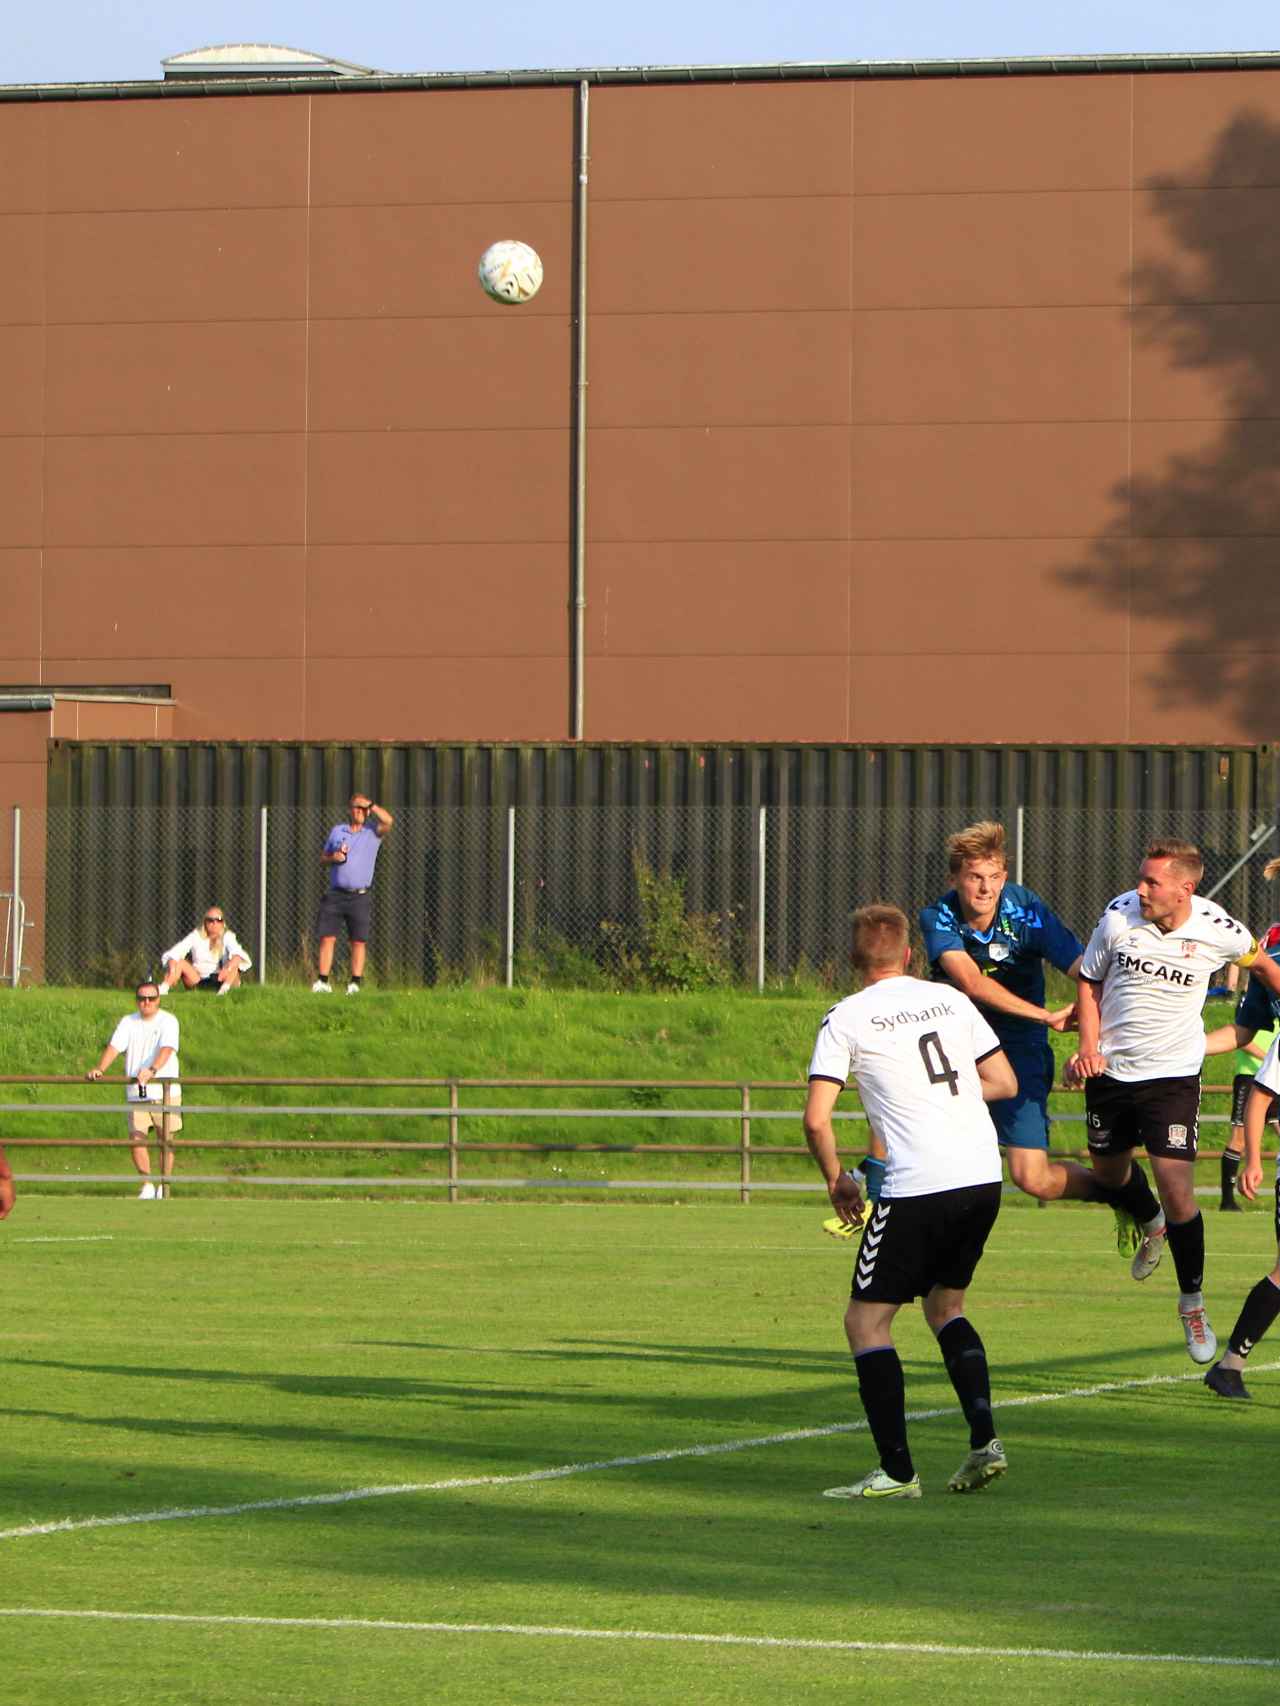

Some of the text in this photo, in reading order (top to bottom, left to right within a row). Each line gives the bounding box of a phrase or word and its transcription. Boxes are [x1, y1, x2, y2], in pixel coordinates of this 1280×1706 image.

[1118, 952, 1195, 987] EMCARE
[870, 1002, 956, 1032] Sydbank
[918, 1031, 959, 1096] 4
